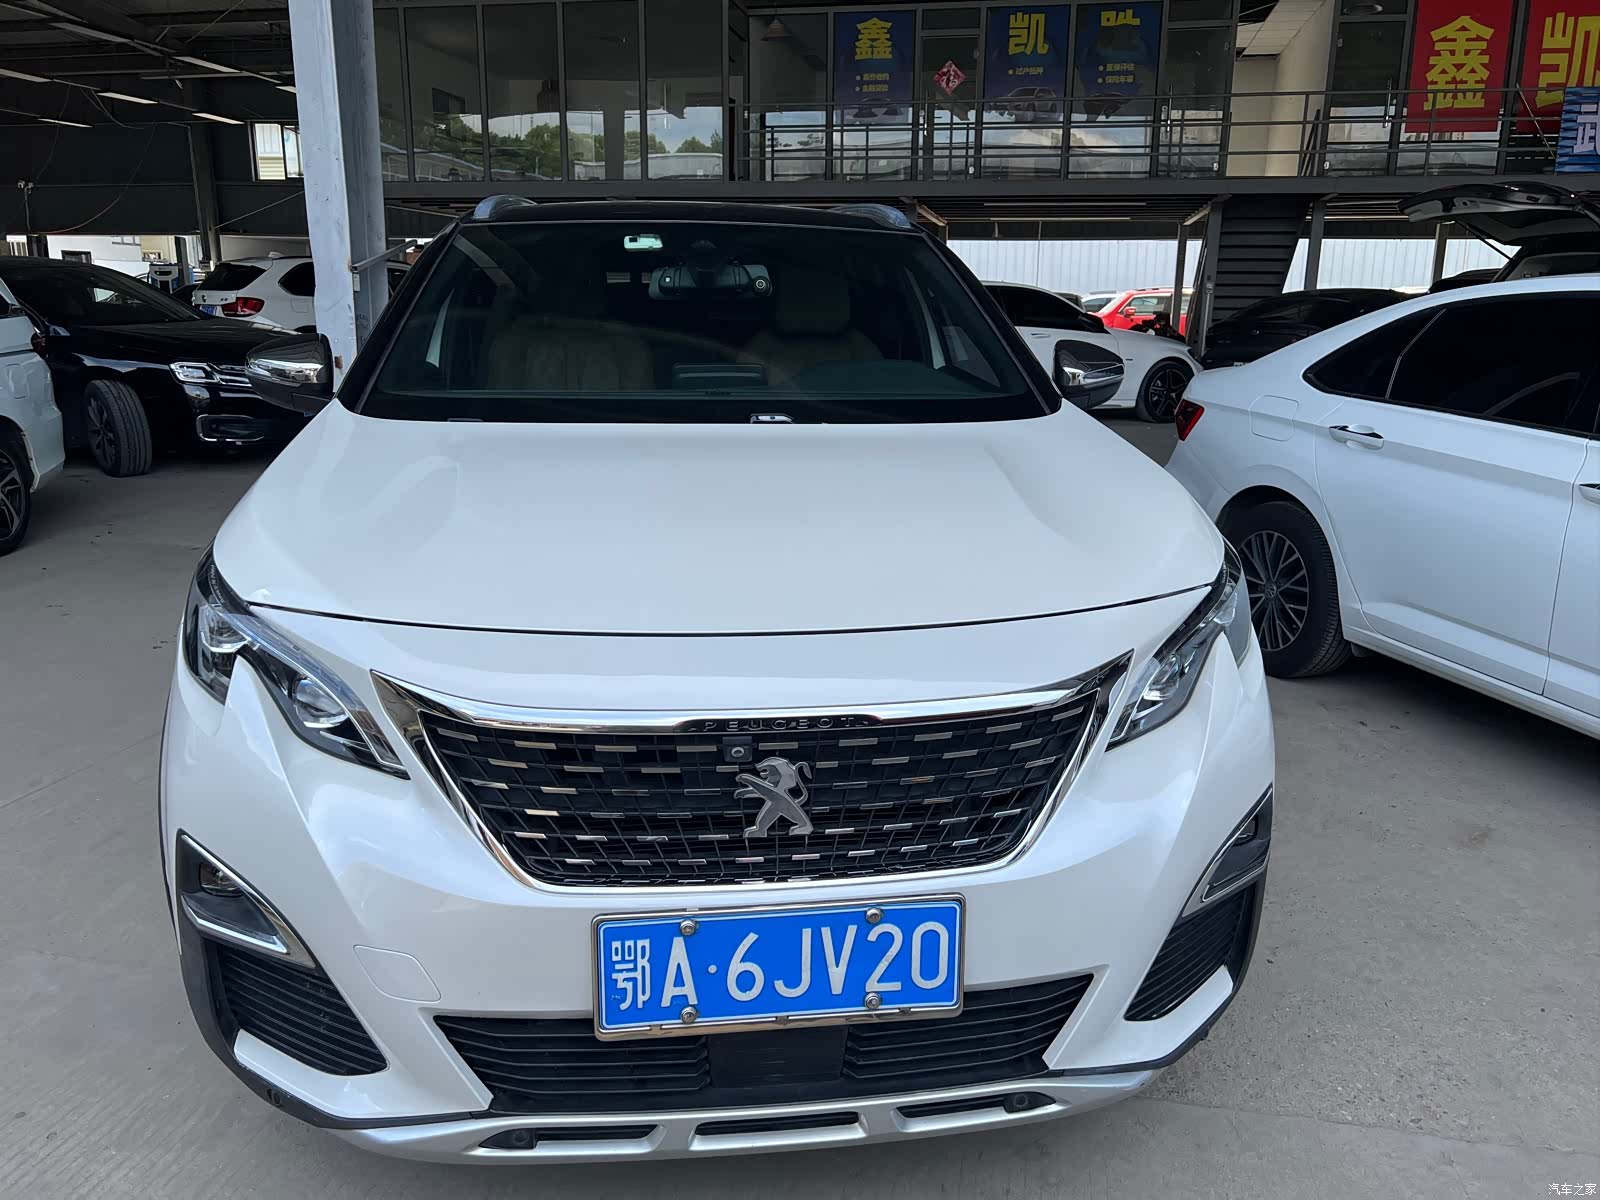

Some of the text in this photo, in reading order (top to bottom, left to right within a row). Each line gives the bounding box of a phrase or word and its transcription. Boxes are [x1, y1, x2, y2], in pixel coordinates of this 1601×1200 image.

[855, 16, 893, 61] 鑫
[1008, 11, 1049, 56] 凯
[1424, 15, 1495, 111] 鑫
[703, 717, 855, 732] PEUGEOT
